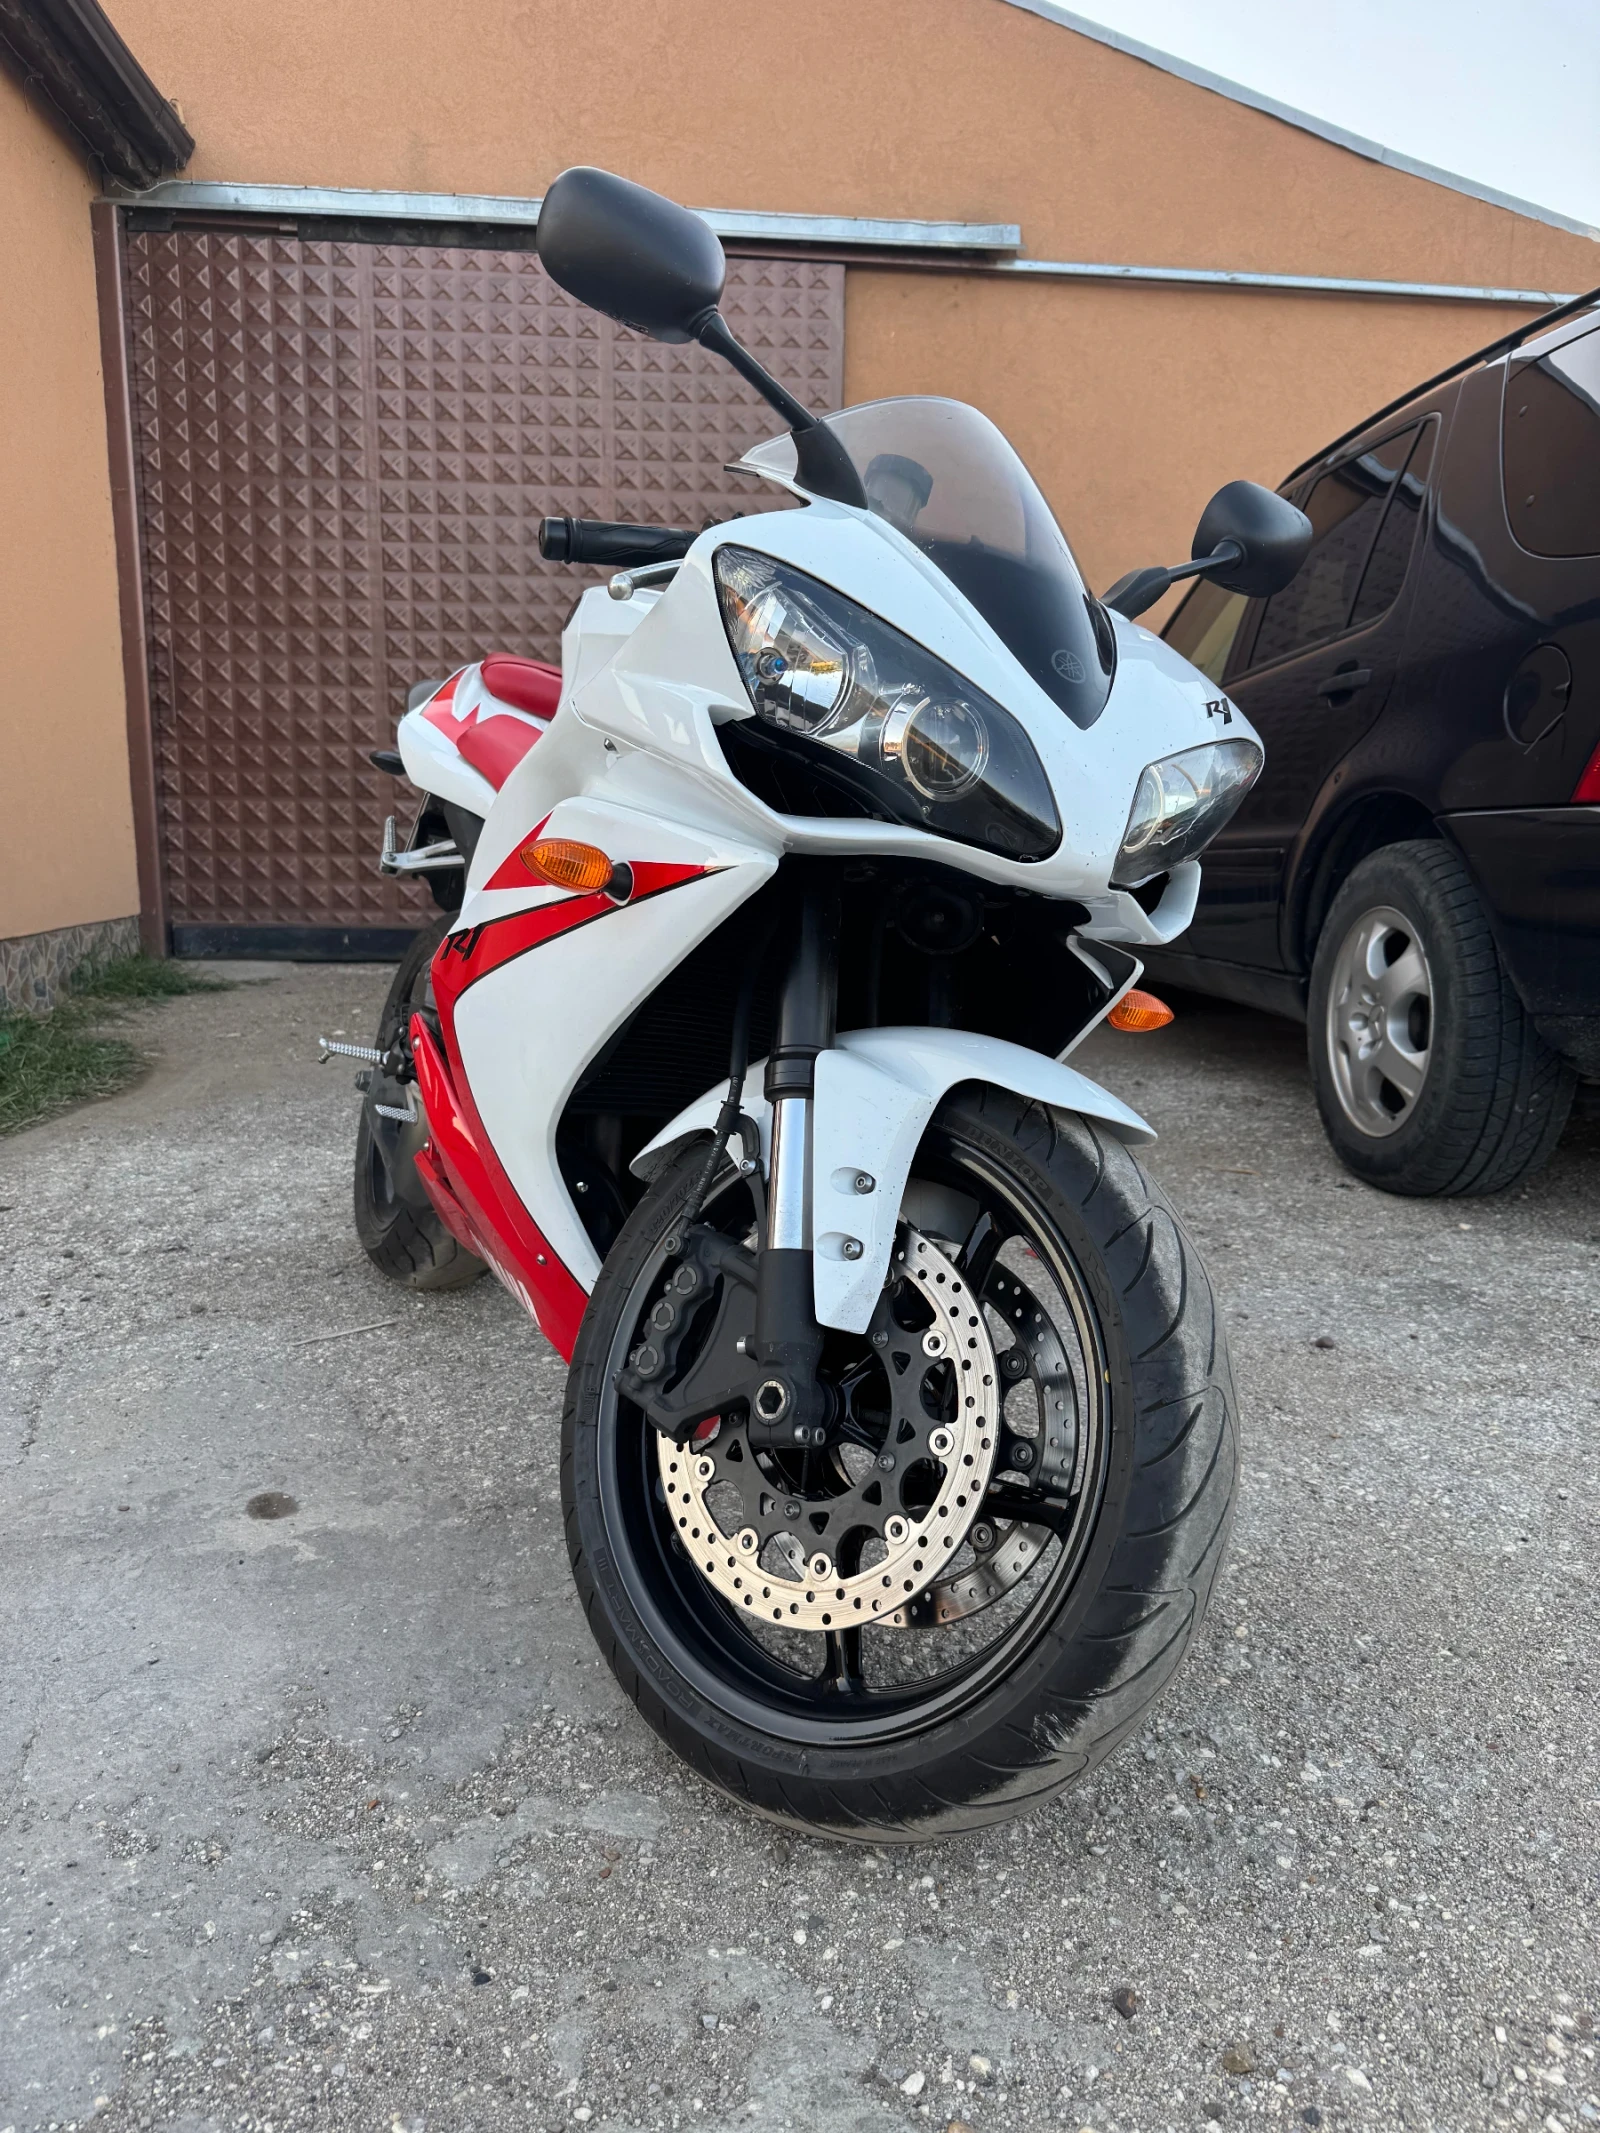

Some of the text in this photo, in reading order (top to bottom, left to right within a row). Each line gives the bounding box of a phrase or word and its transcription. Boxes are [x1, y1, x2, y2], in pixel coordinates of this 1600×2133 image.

[1201, 698, 1232, 725] R1
[440, 923, 486, 962] R1
[965, 1126, 1048, 1191] DUNLOP
[607, 1583, 694, 1710] ROADSMART
[703, 1715, 799, 1762] SPORTMAX
